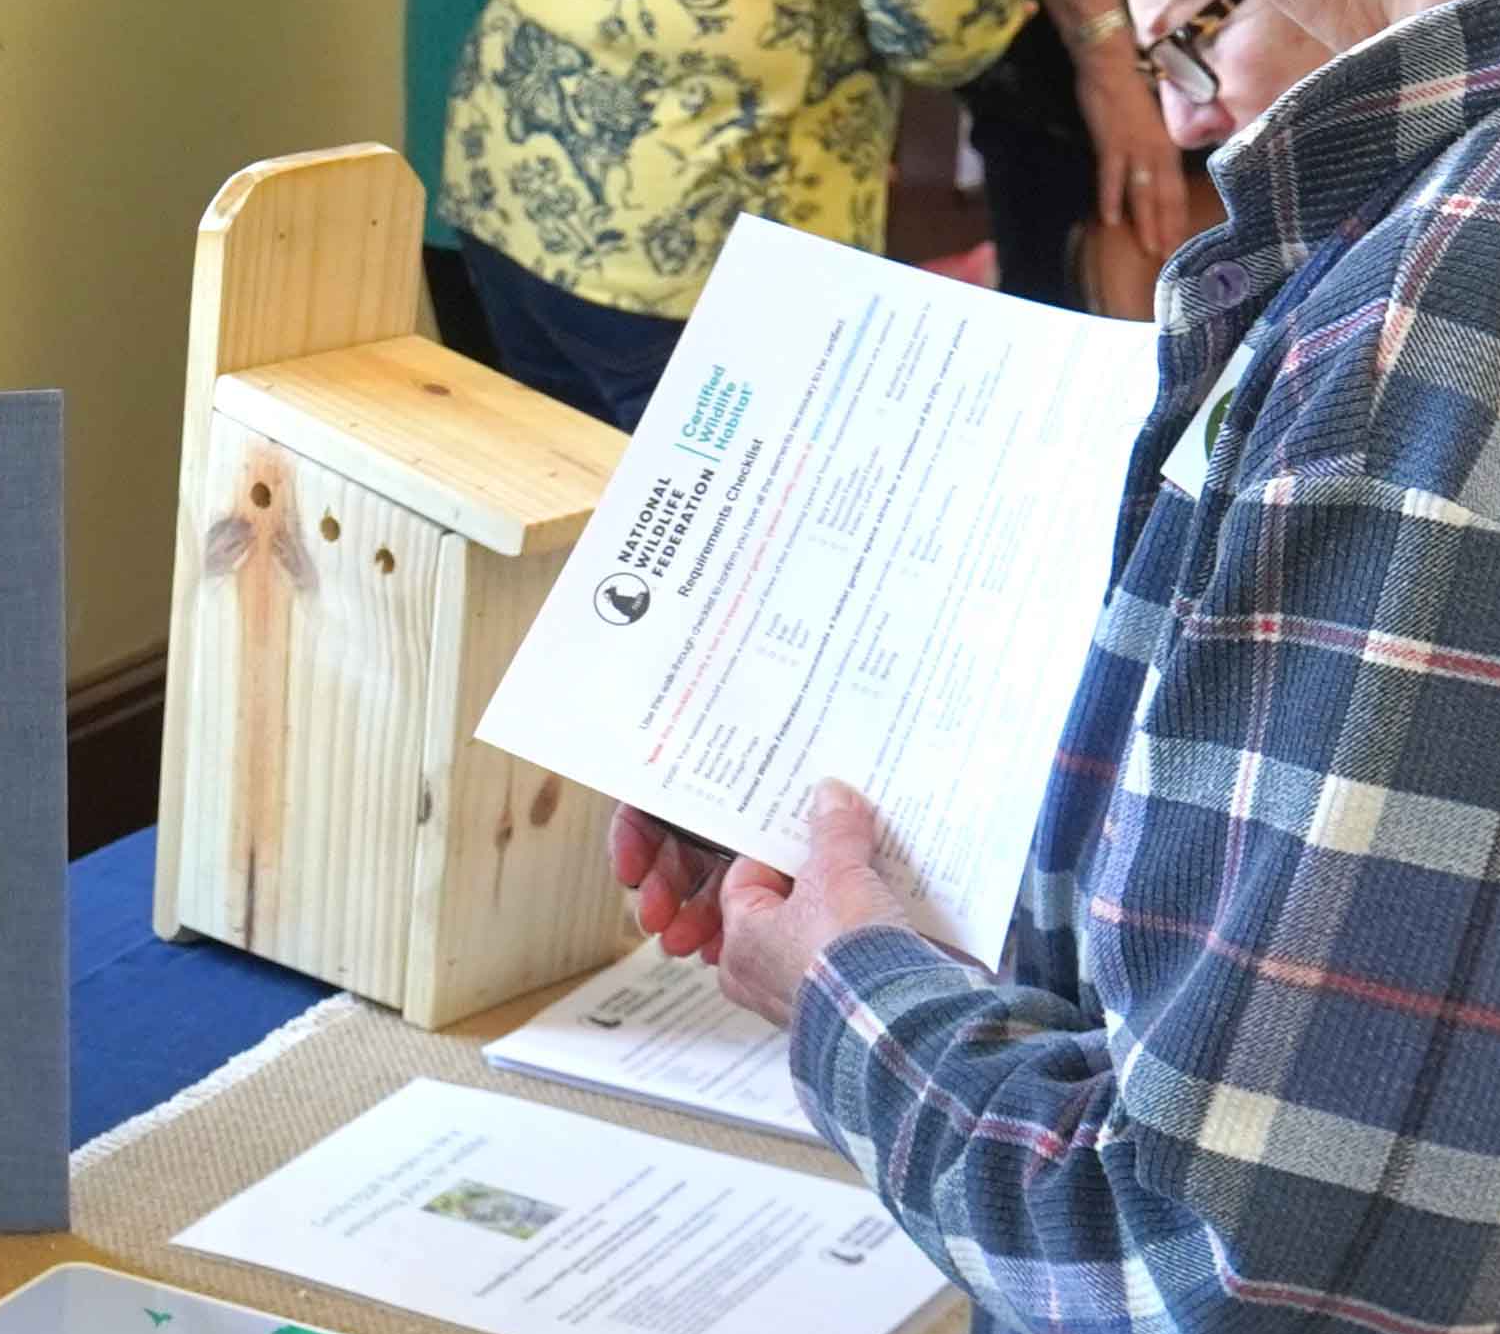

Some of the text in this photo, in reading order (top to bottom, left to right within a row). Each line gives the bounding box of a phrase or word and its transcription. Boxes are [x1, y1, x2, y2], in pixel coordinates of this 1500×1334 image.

[682, 364, 726, 438] Certified
[698, 382, 737, 444] Wildlife
[618, 475, 672, 563] NATIONAL
[634, 488, 685, 569] WILDLIFE
[652, 468, 715, 578] FEDERATION
[678, 503, 732, 597] Requirements
[726, 439, 764, 501] Checklist
[734, 532, 749, 551] you
[743, 507, 759, 531] have
[760, 477, 774, 493] the
